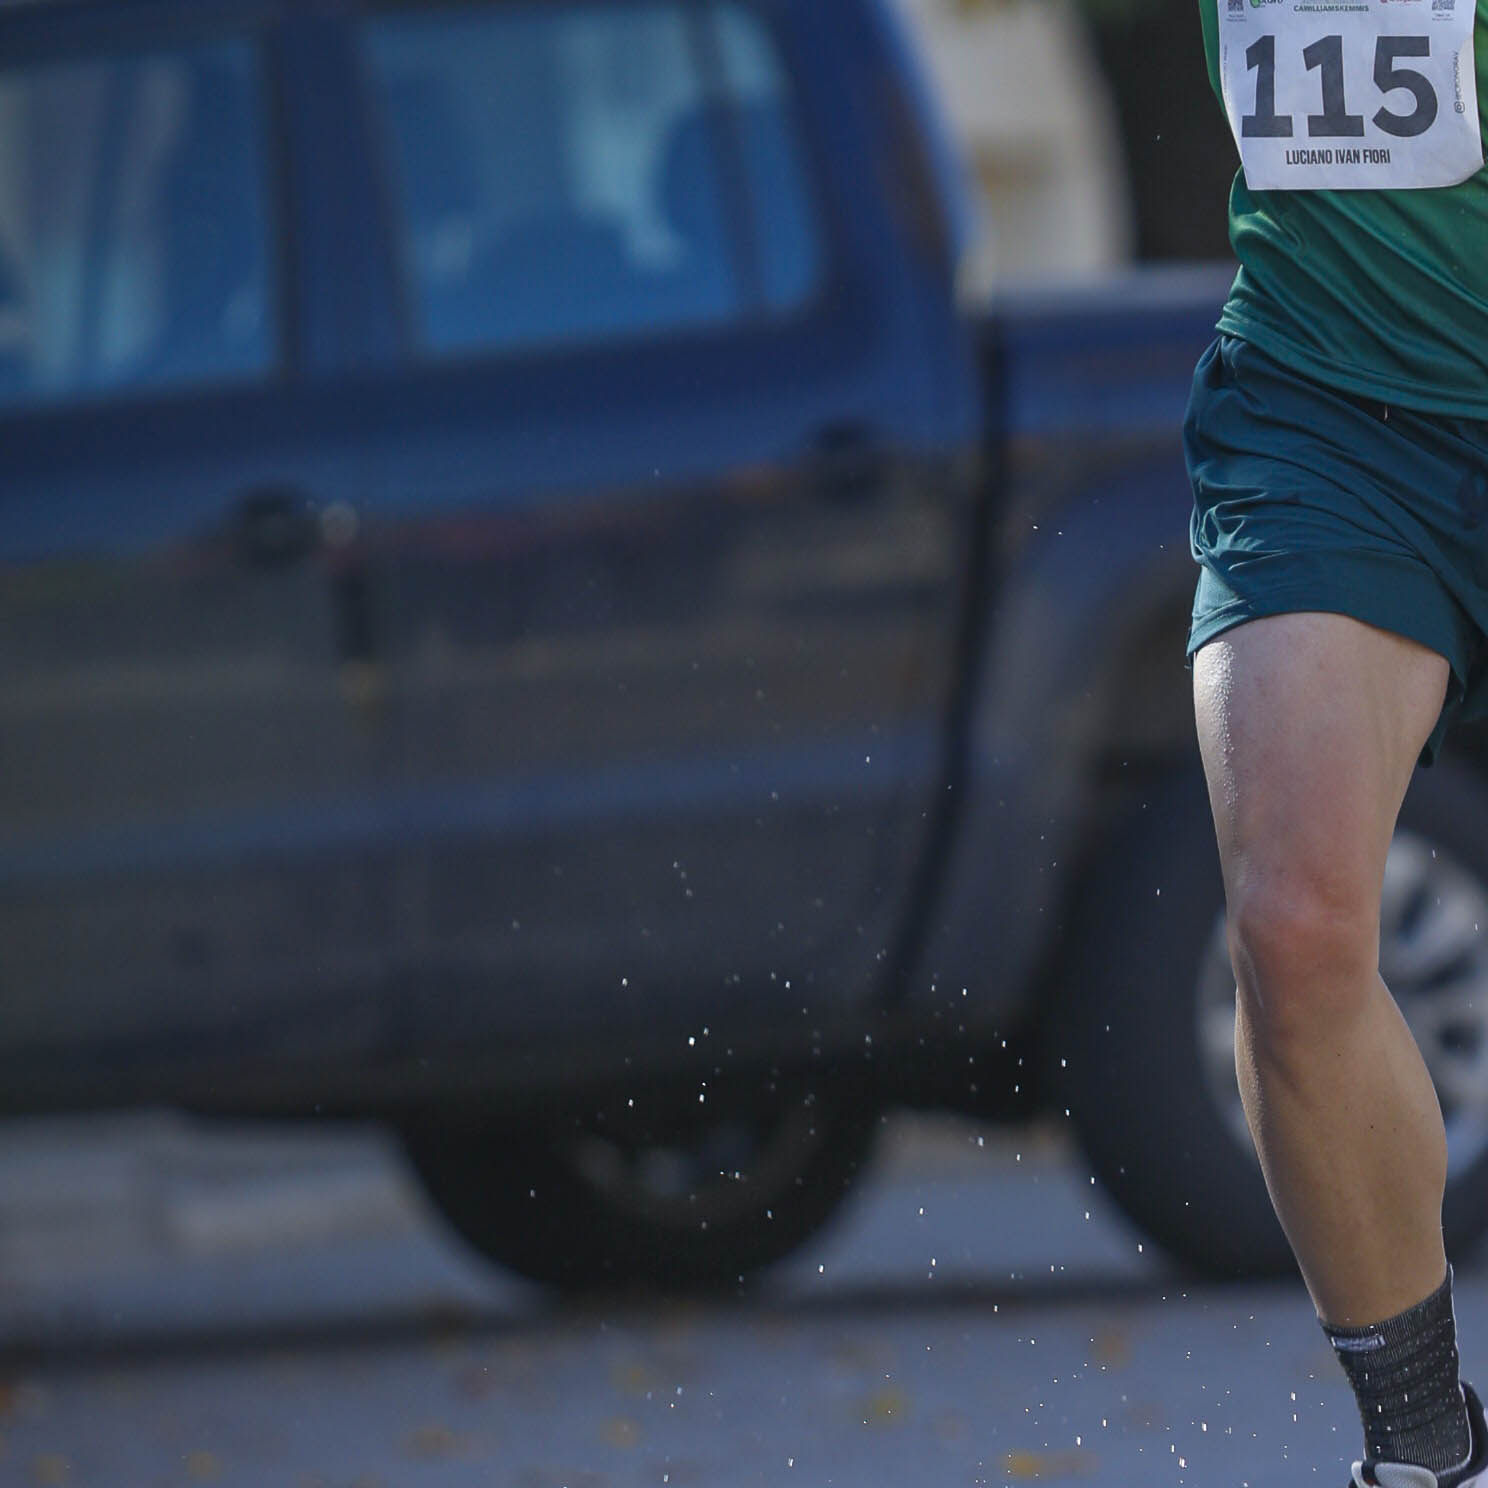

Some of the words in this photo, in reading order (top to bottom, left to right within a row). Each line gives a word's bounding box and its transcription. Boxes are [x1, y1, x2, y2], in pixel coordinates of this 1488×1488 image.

[1241, 35, 1438, 137] 115
[1286, 150, 1332, 165] LUCIANO
[1335, 149, 1360, 164] IVAN
[1362, 149, 1391, 164] FIORI
